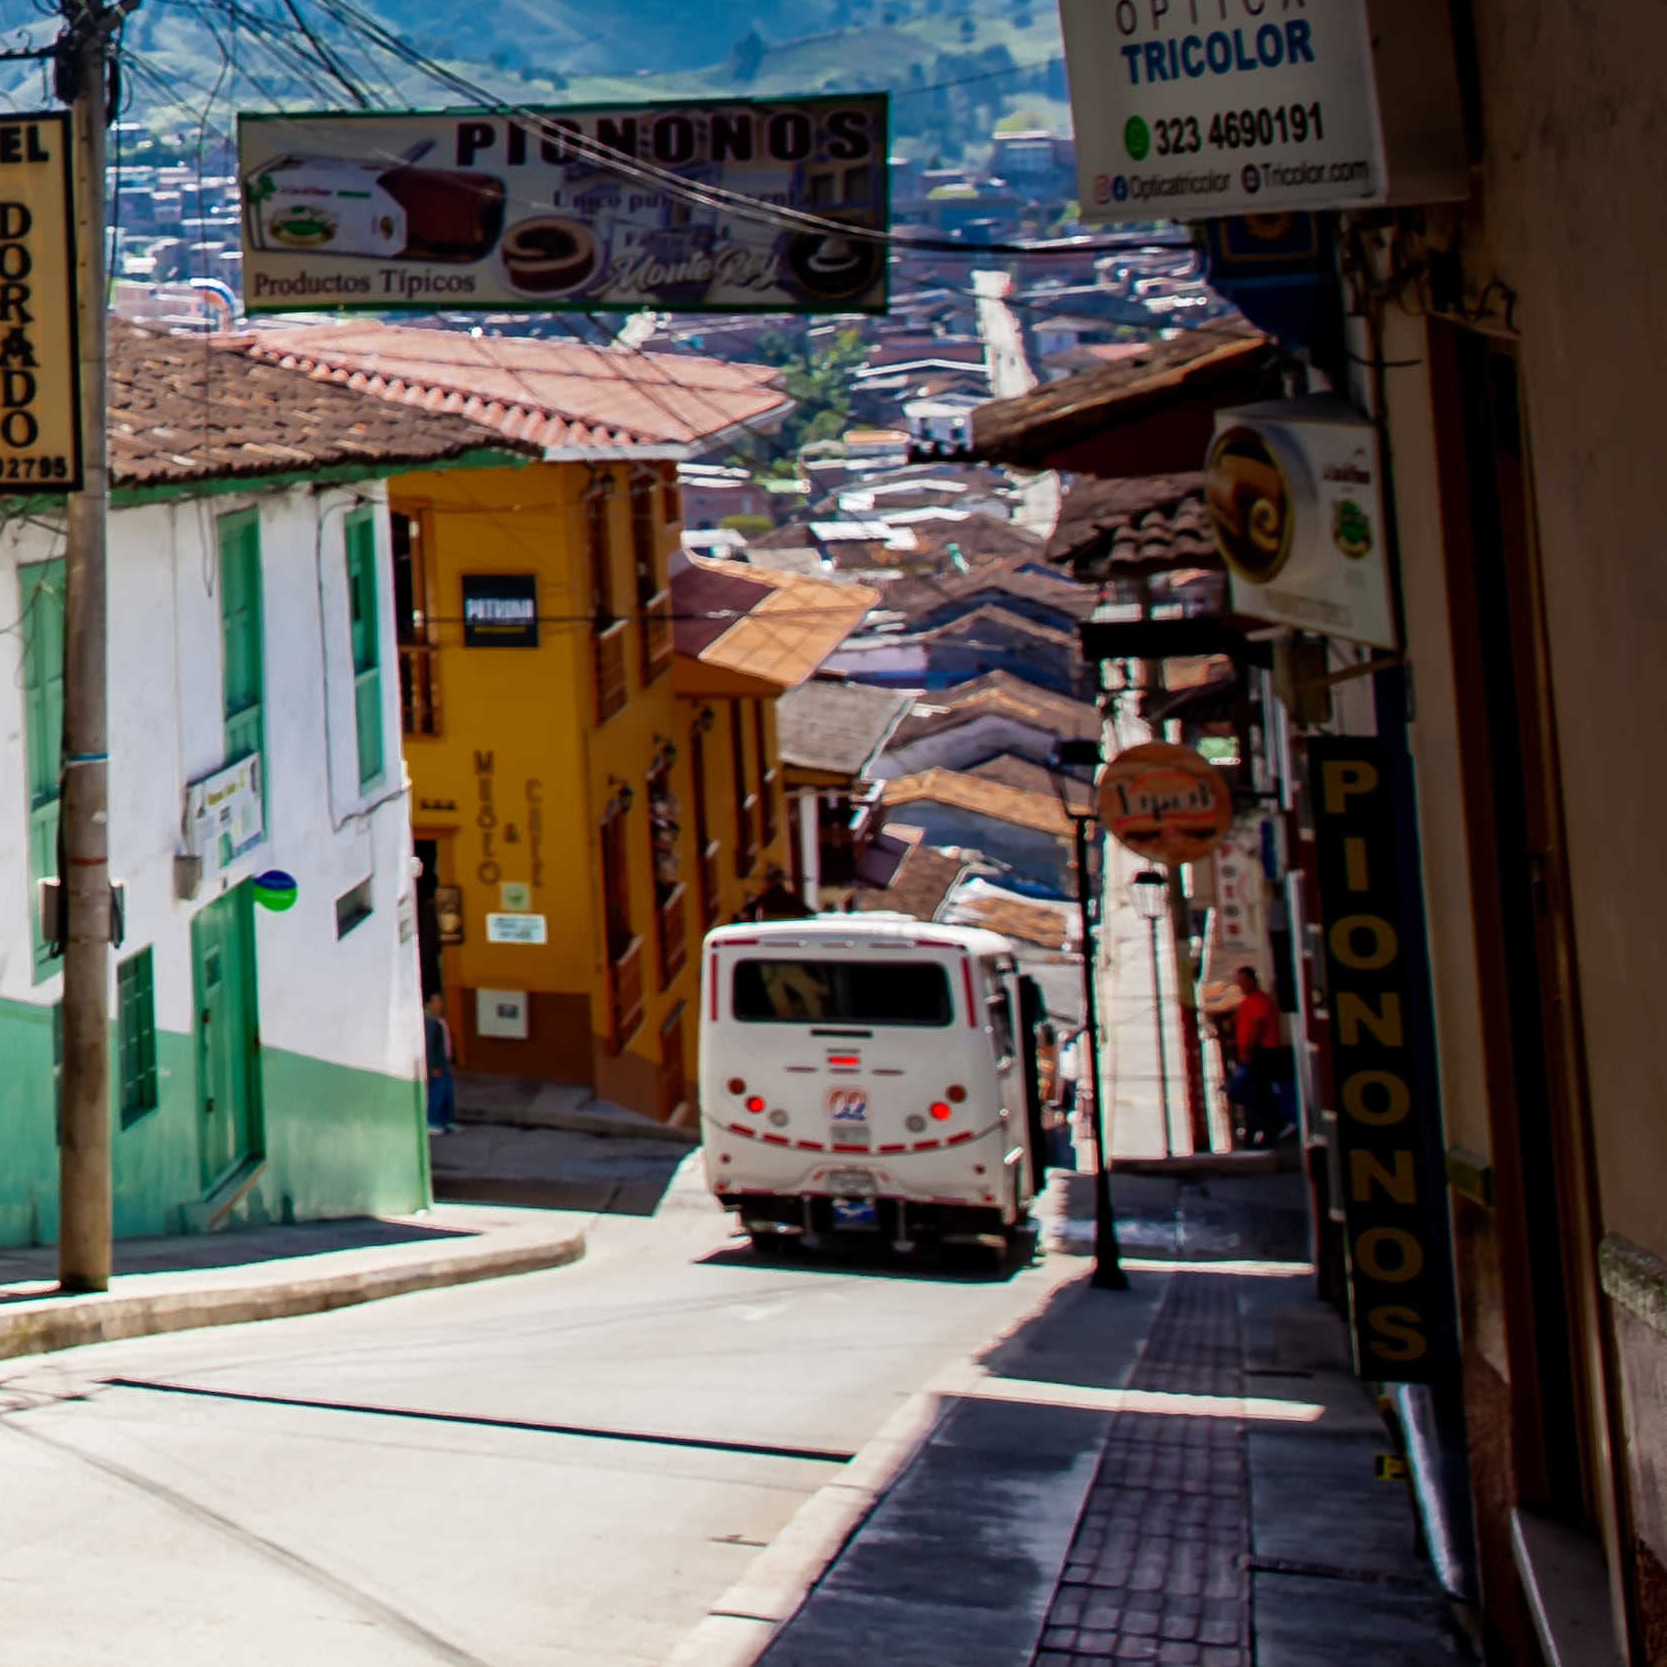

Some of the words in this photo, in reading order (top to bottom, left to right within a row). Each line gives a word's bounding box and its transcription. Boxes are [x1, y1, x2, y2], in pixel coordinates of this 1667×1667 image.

[1120, 18, 1316, 86] TRICOLOR
[455, 110, 872, 167] PIONONOS
[1154, 115, 1202, 157] 323
[1208, 100, 1325, 151] 4690191
[254, 269, 371, 297] Productos
[378, 267, 476, 295] Típicos
[589, 250, 714, 300] Monte
[1324, 759, 1429, 1362] PIONONOS
